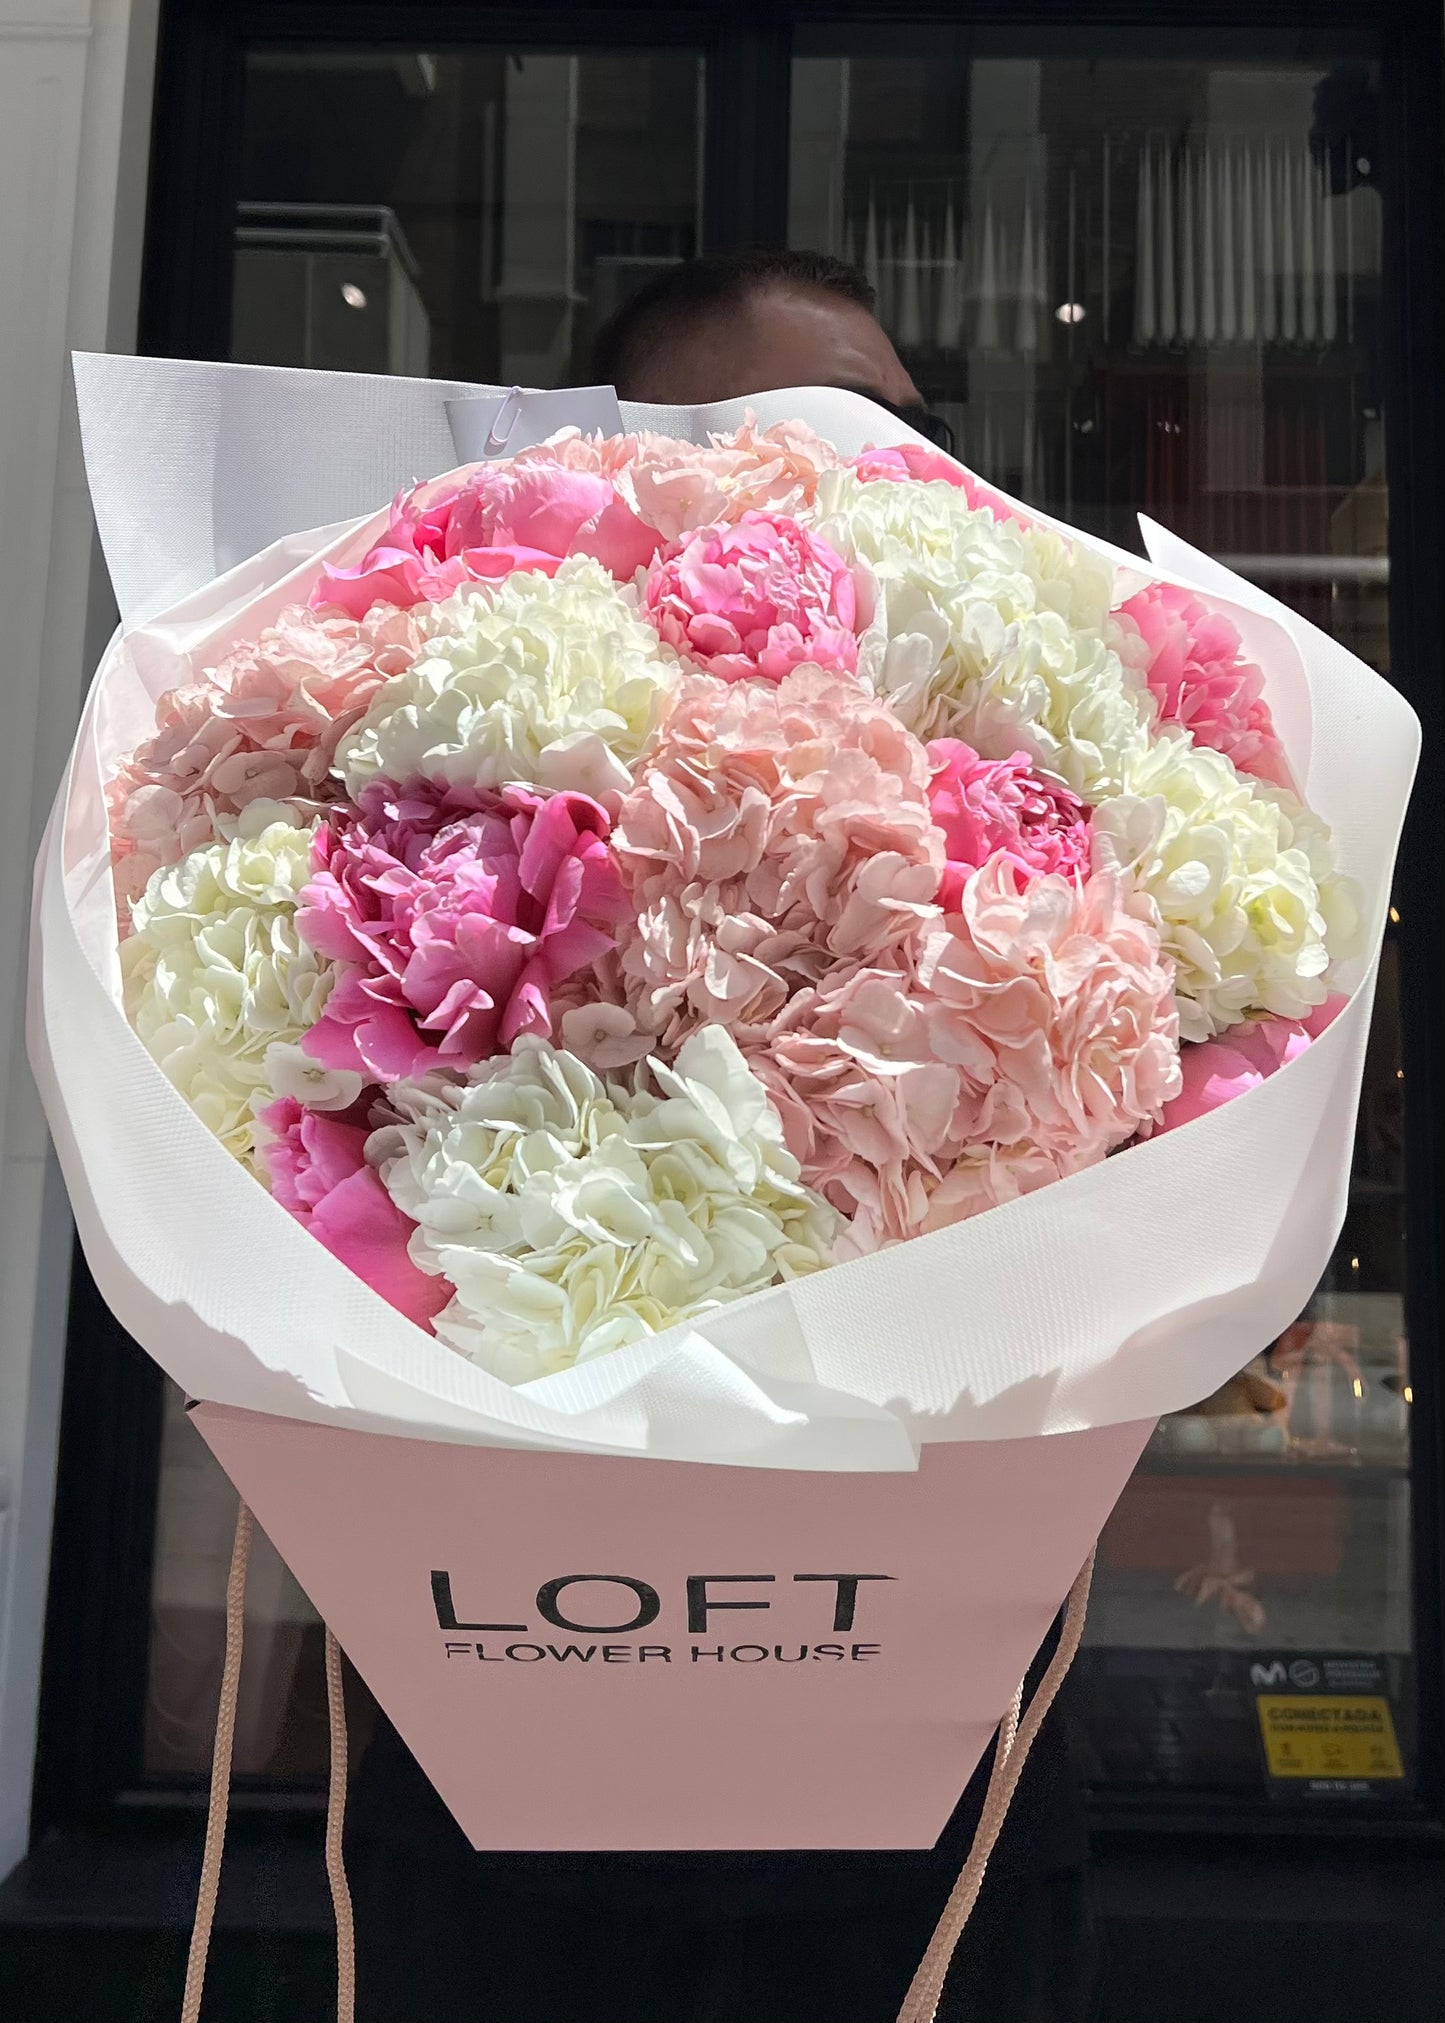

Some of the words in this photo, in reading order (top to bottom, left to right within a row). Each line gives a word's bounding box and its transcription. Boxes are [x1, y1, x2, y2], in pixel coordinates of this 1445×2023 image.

[430, 1569, 898, 1634] LOFT
[444, 1642, 672, 1663] FLOWER
[691, 1643, 882, 1663] HOUSE
